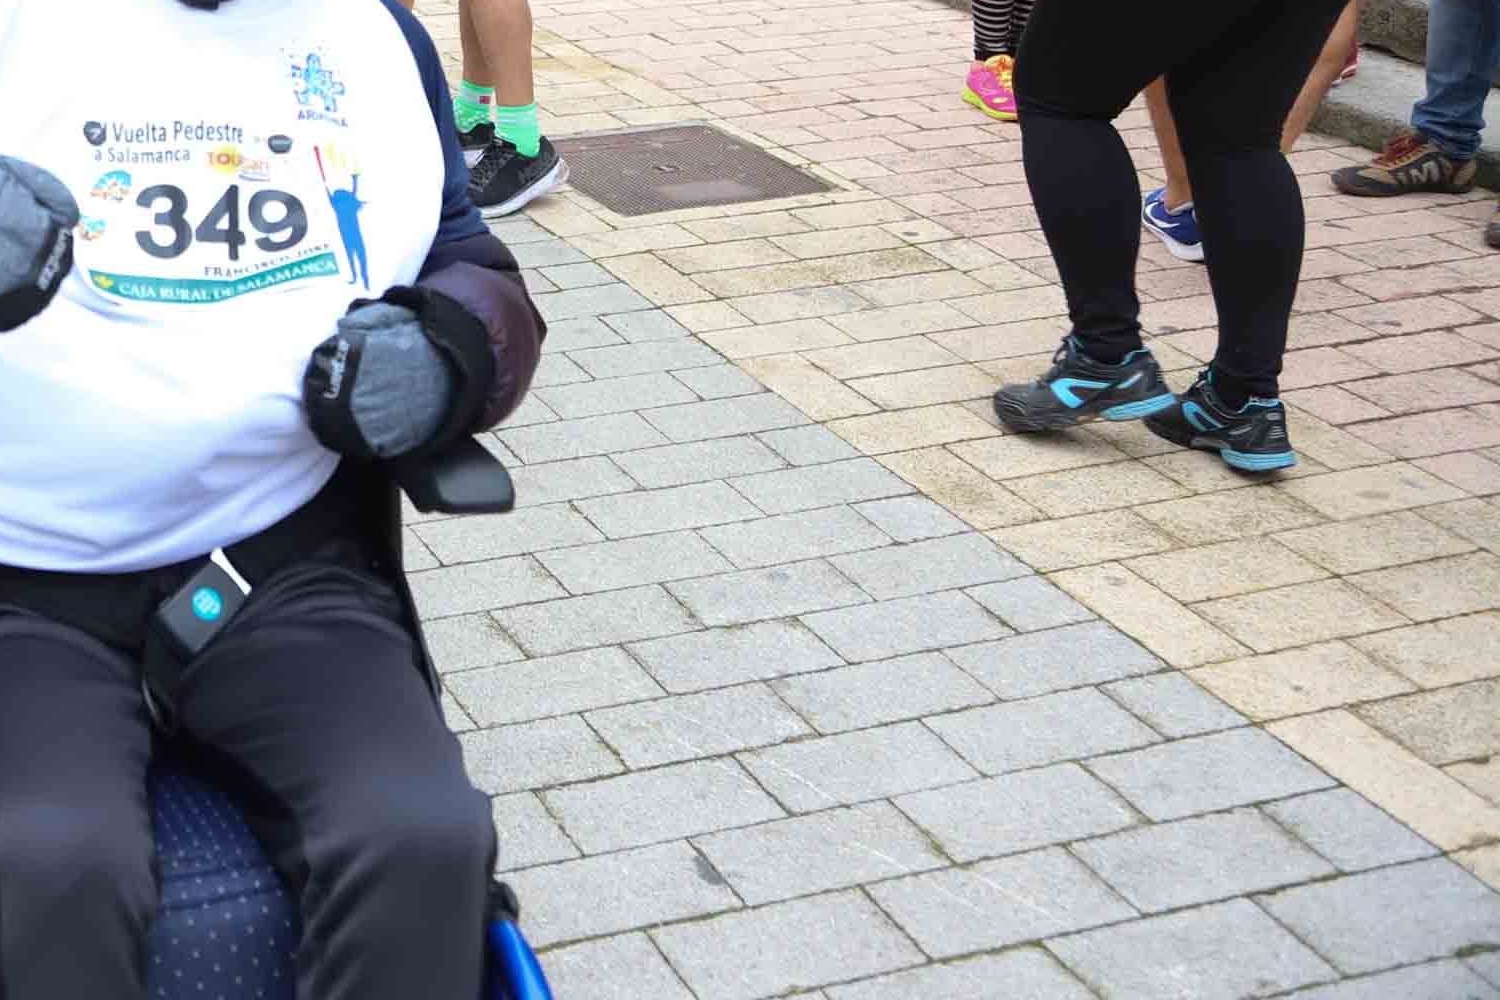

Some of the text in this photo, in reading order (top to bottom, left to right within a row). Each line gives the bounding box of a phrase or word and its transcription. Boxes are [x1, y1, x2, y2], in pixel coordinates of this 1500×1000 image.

[112, 120, 244, 144] Vuelta Pedestre
[93, 146, 191, 164] a Salamanca
[134, 184, 309, 262] 349
[159, 284, 211, 302] RURAL
[213, 285, 234, 300] DE
[234, 259, 337, 296] SALAMANCA
